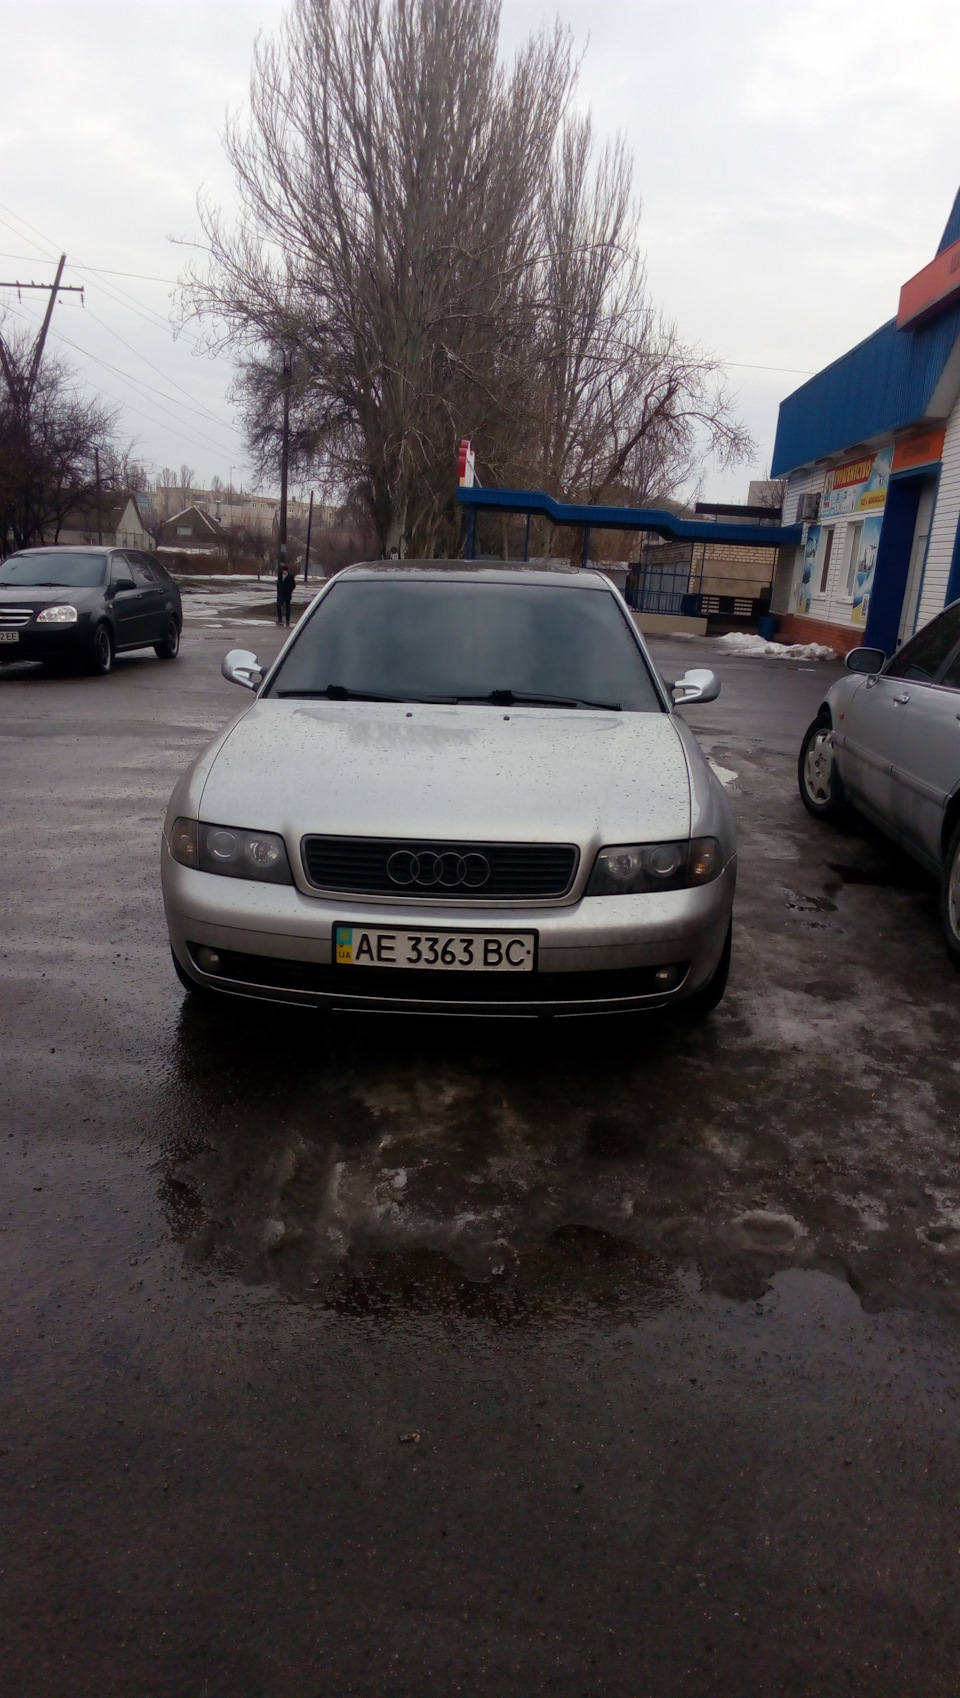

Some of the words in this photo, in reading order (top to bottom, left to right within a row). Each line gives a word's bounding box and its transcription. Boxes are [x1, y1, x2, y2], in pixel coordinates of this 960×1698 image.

[6, 632, 17, 641] EE
[355, 933, 397, 962] AE
[406, 935, 474, 965] 3363
[483, 938, 525, 967] BC
[338, 951, 351, 959] UA
